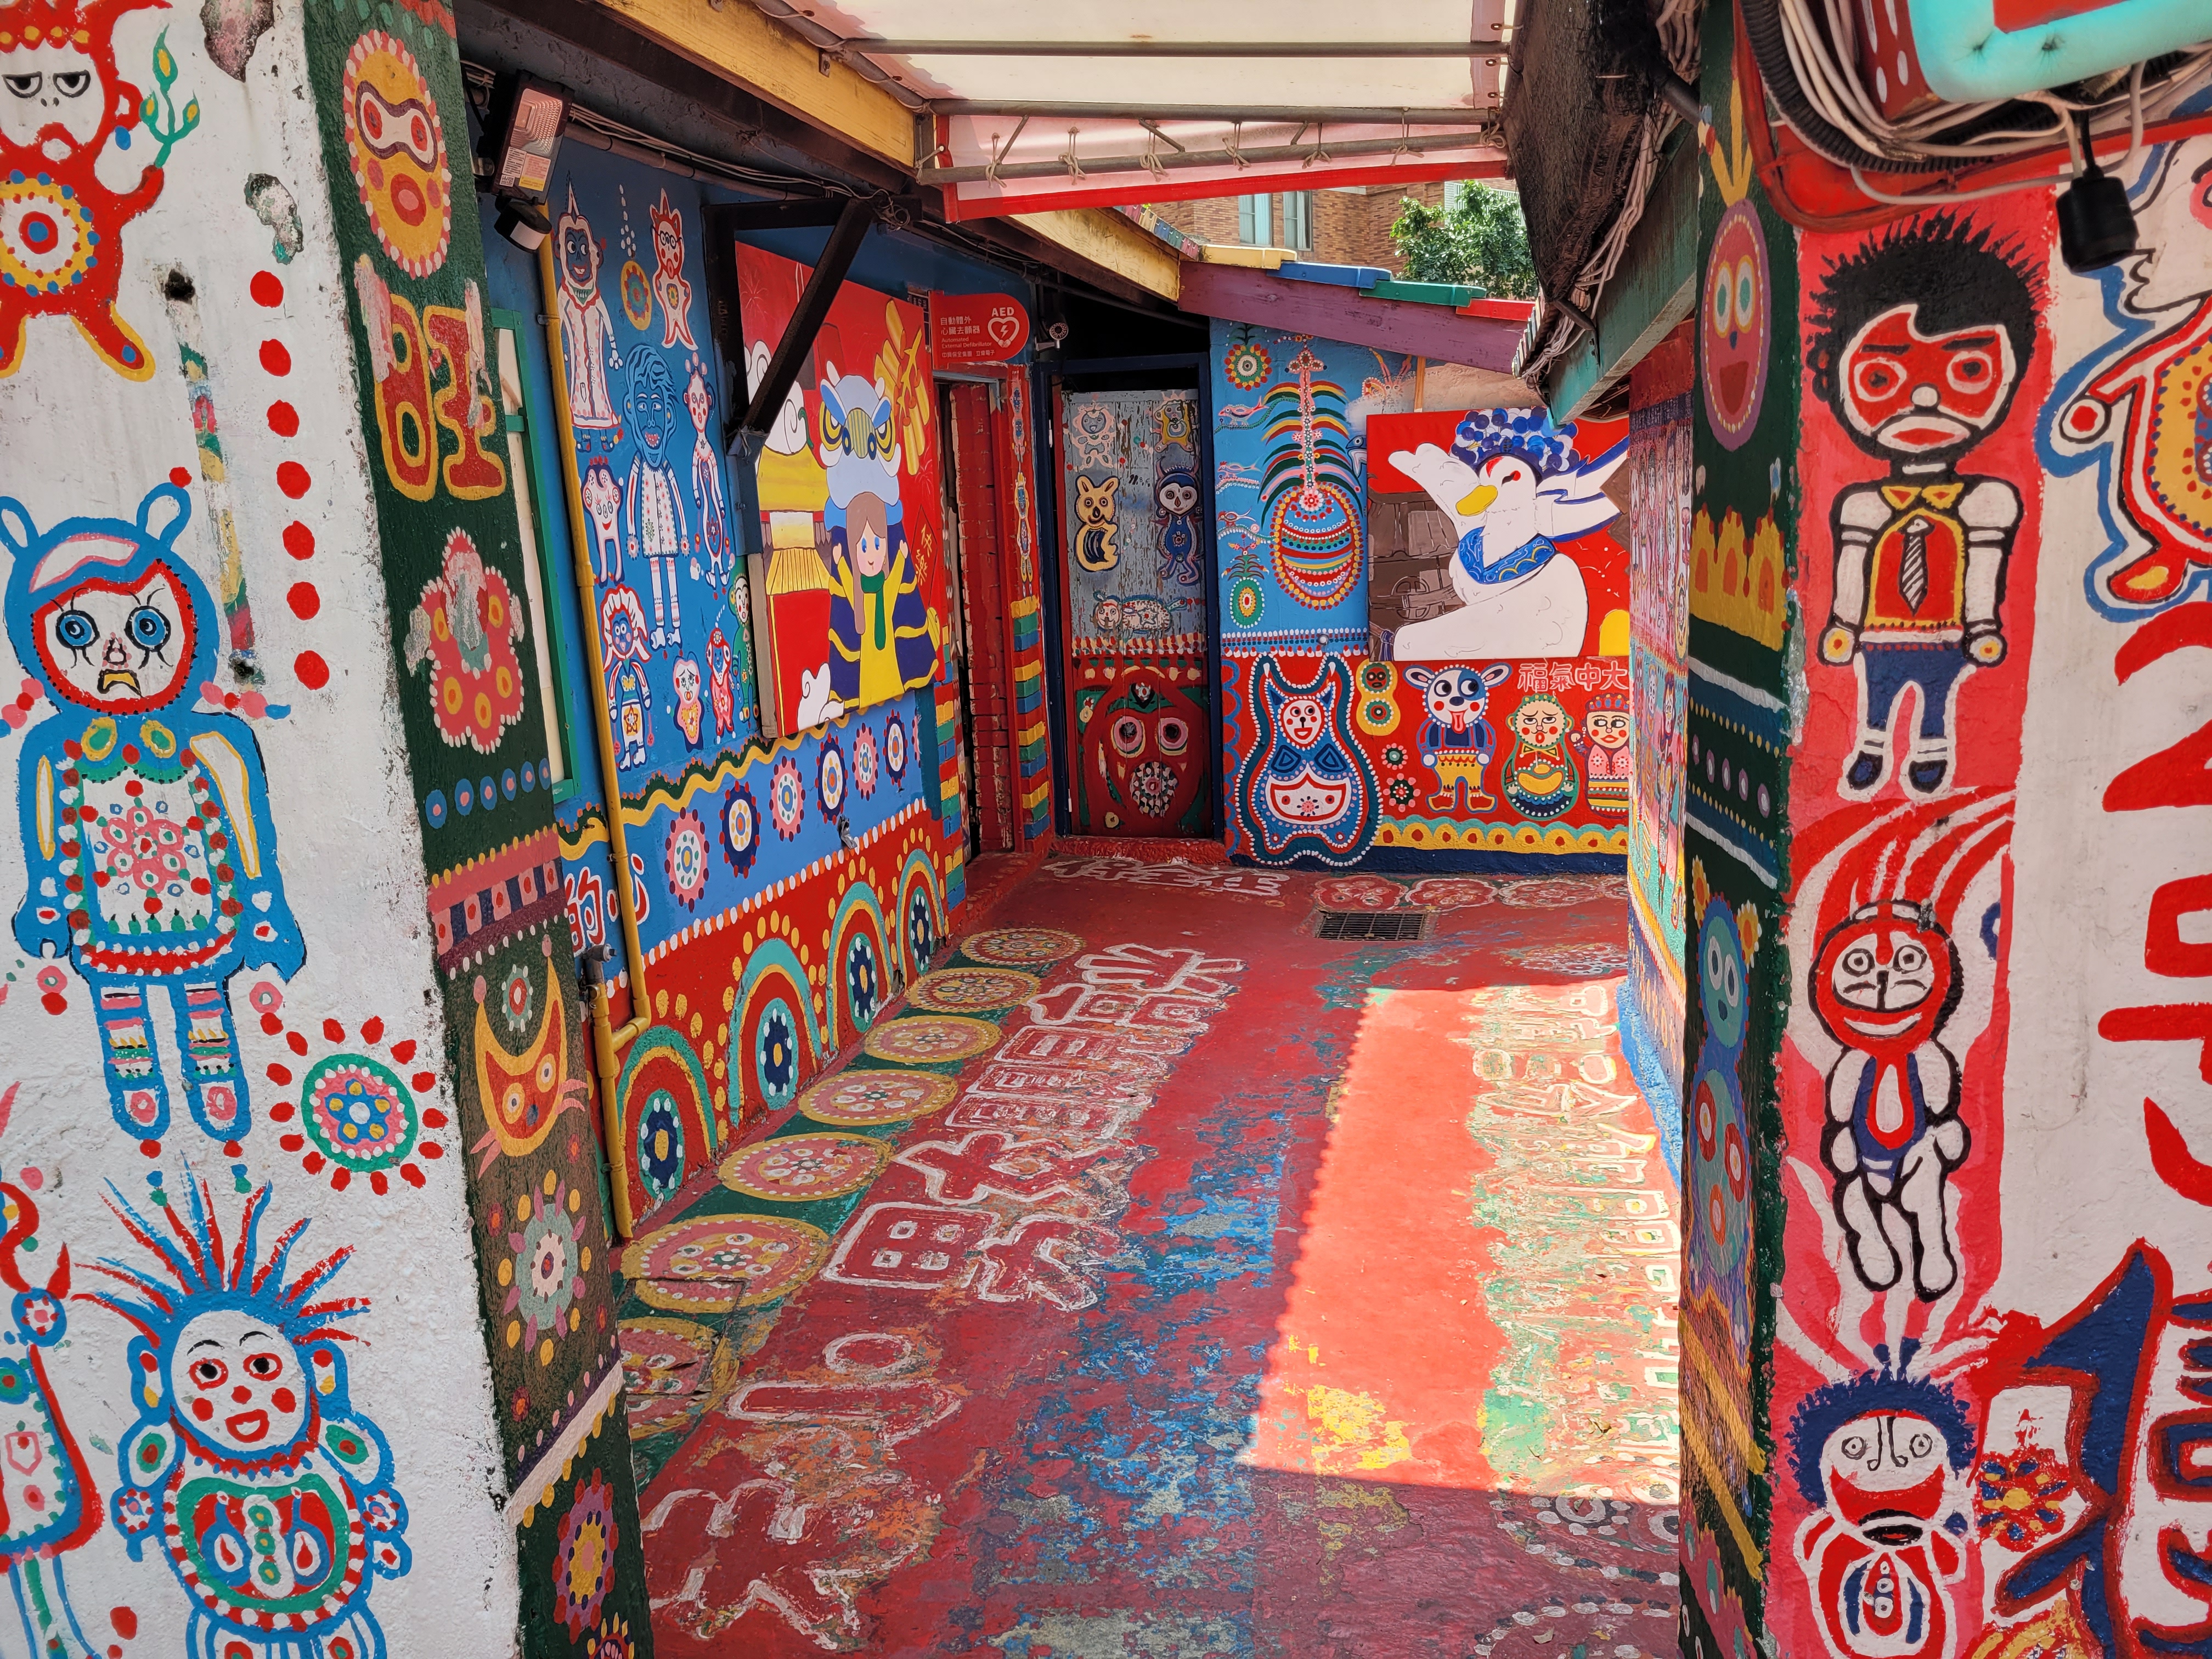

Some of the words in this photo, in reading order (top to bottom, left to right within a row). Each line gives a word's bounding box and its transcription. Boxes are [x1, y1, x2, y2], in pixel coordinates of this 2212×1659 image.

[991, 307, 1014, 317] AED
[940, 315, 971, 325] 自動體外
[1517, 661, 1629, 693] 福氣中大
